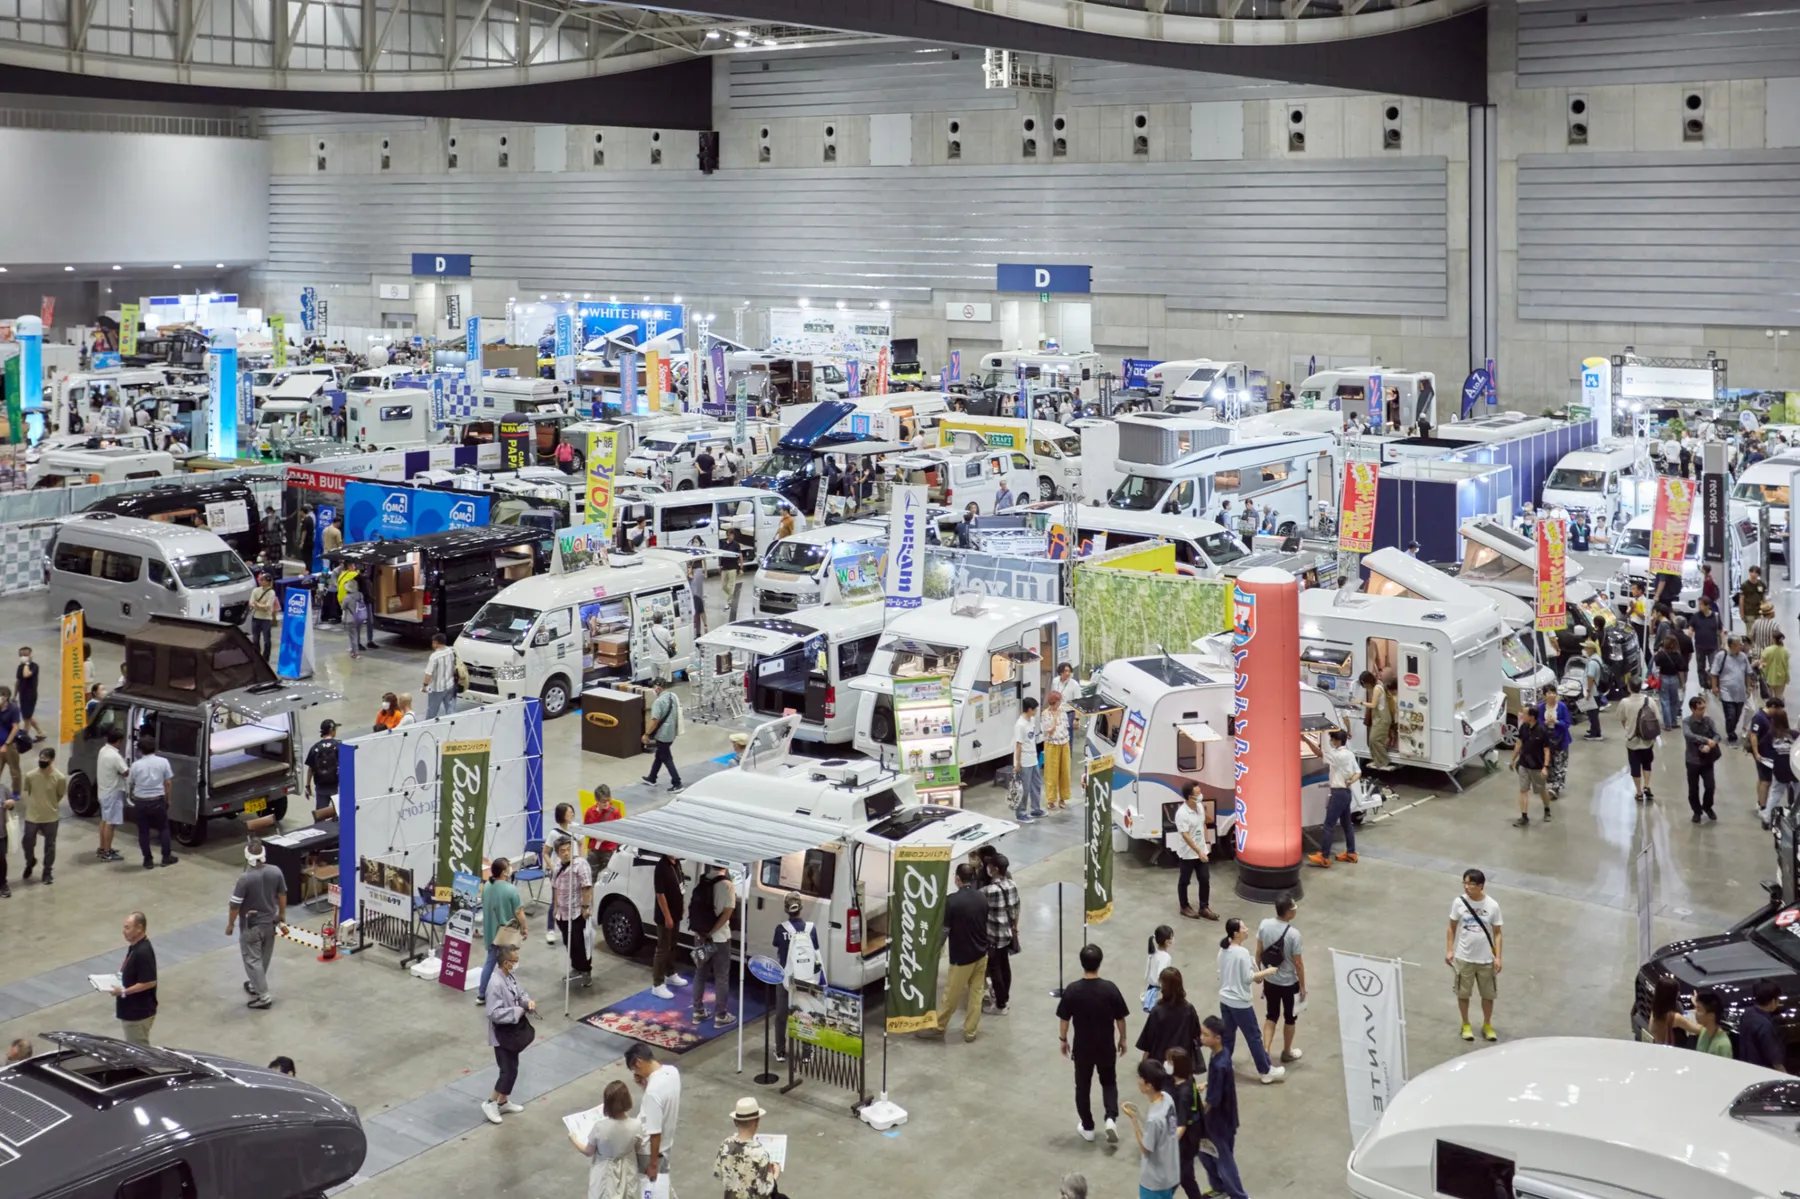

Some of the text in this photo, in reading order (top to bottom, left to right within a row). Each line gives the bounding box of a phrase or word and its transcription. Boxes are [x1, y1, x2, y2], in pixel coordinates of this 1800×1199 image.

[435, 257, 446, 272] D
[1034, 268, 1050, 288] D
[588, 308, 629, 319] WHITE
[385, 503, 405, 513] OMC
[452, 511, 472, 522] OMC
[1125, 727, 1142, 748] 27
[918, 919, 928, 946] ボーテ
